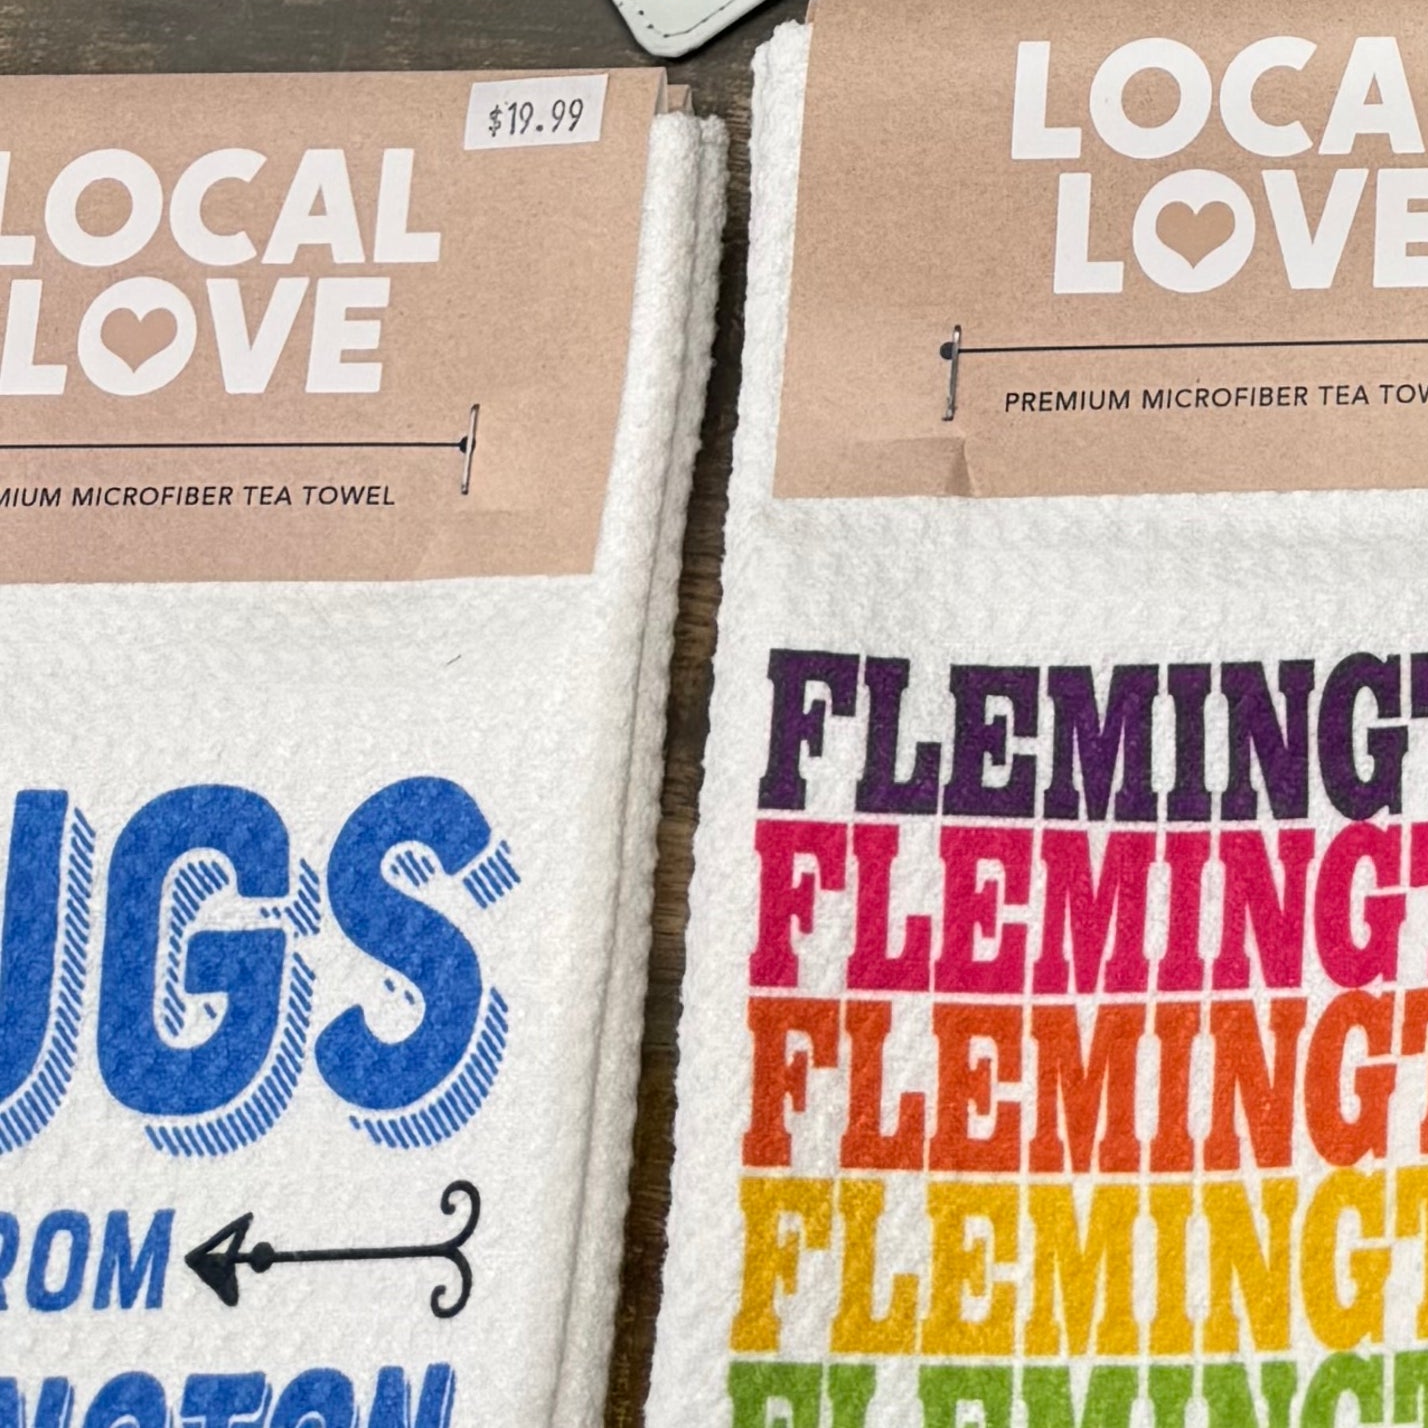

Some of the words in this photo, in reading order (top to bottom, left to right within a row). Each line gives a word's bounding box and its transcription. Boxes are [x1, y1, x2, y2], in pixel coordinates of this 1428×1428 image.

[487, 97, 586, 139] $19.99
[0, 147, 442, 268] LOCAL
[0, 275, 391, 396] LOVE
[1003, 388, 1132, 414] PREMIUM
[1140, 384, 1310, 411] MICROFIBER
[1317, 383, 1372, 409] TEA
[71, 484, 235, 508] MICROFIBER
[242, 484, 294, 507] TEA
[302, 484, 397, 507] TOWEL
